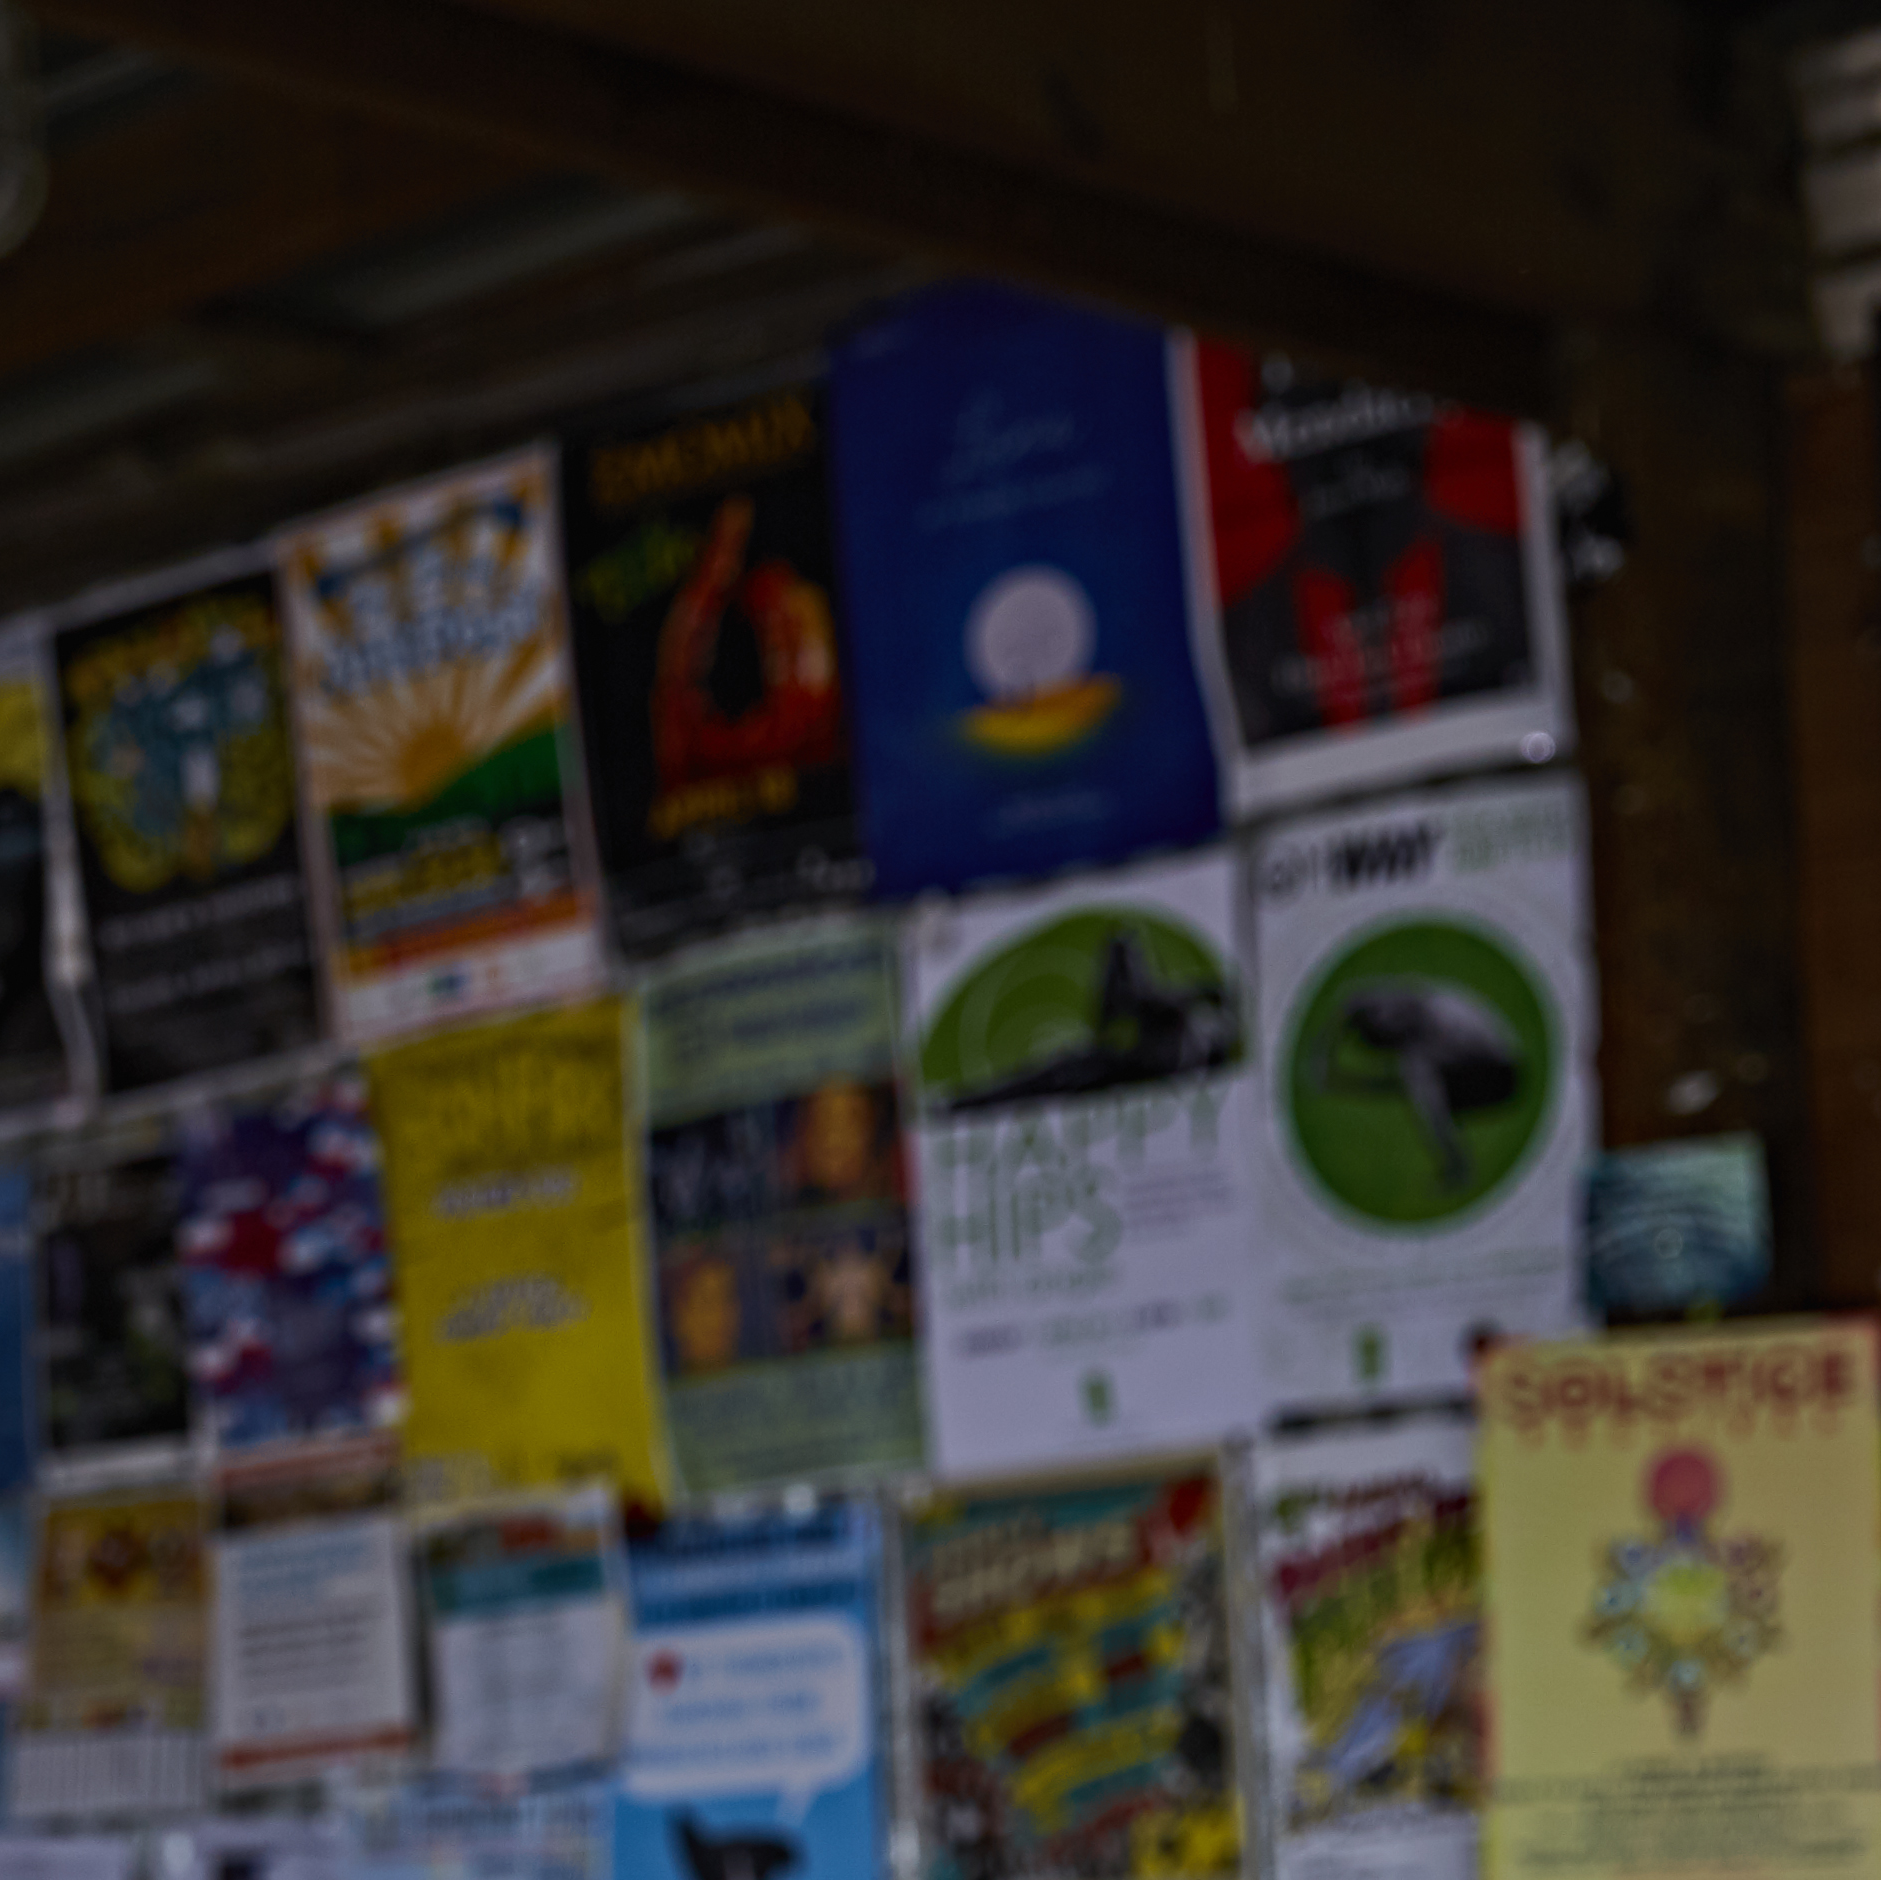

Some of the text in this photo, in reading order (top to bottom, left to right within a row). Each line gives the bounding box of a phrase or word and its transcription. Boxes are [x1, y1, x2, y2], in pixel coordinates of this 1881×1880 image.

[934, 1084, 1225, 1180] HAPPY
[934, 1168, 1119, 1270] HIPS
[1499, 1348, 1857, 1421] SOLSTICE
